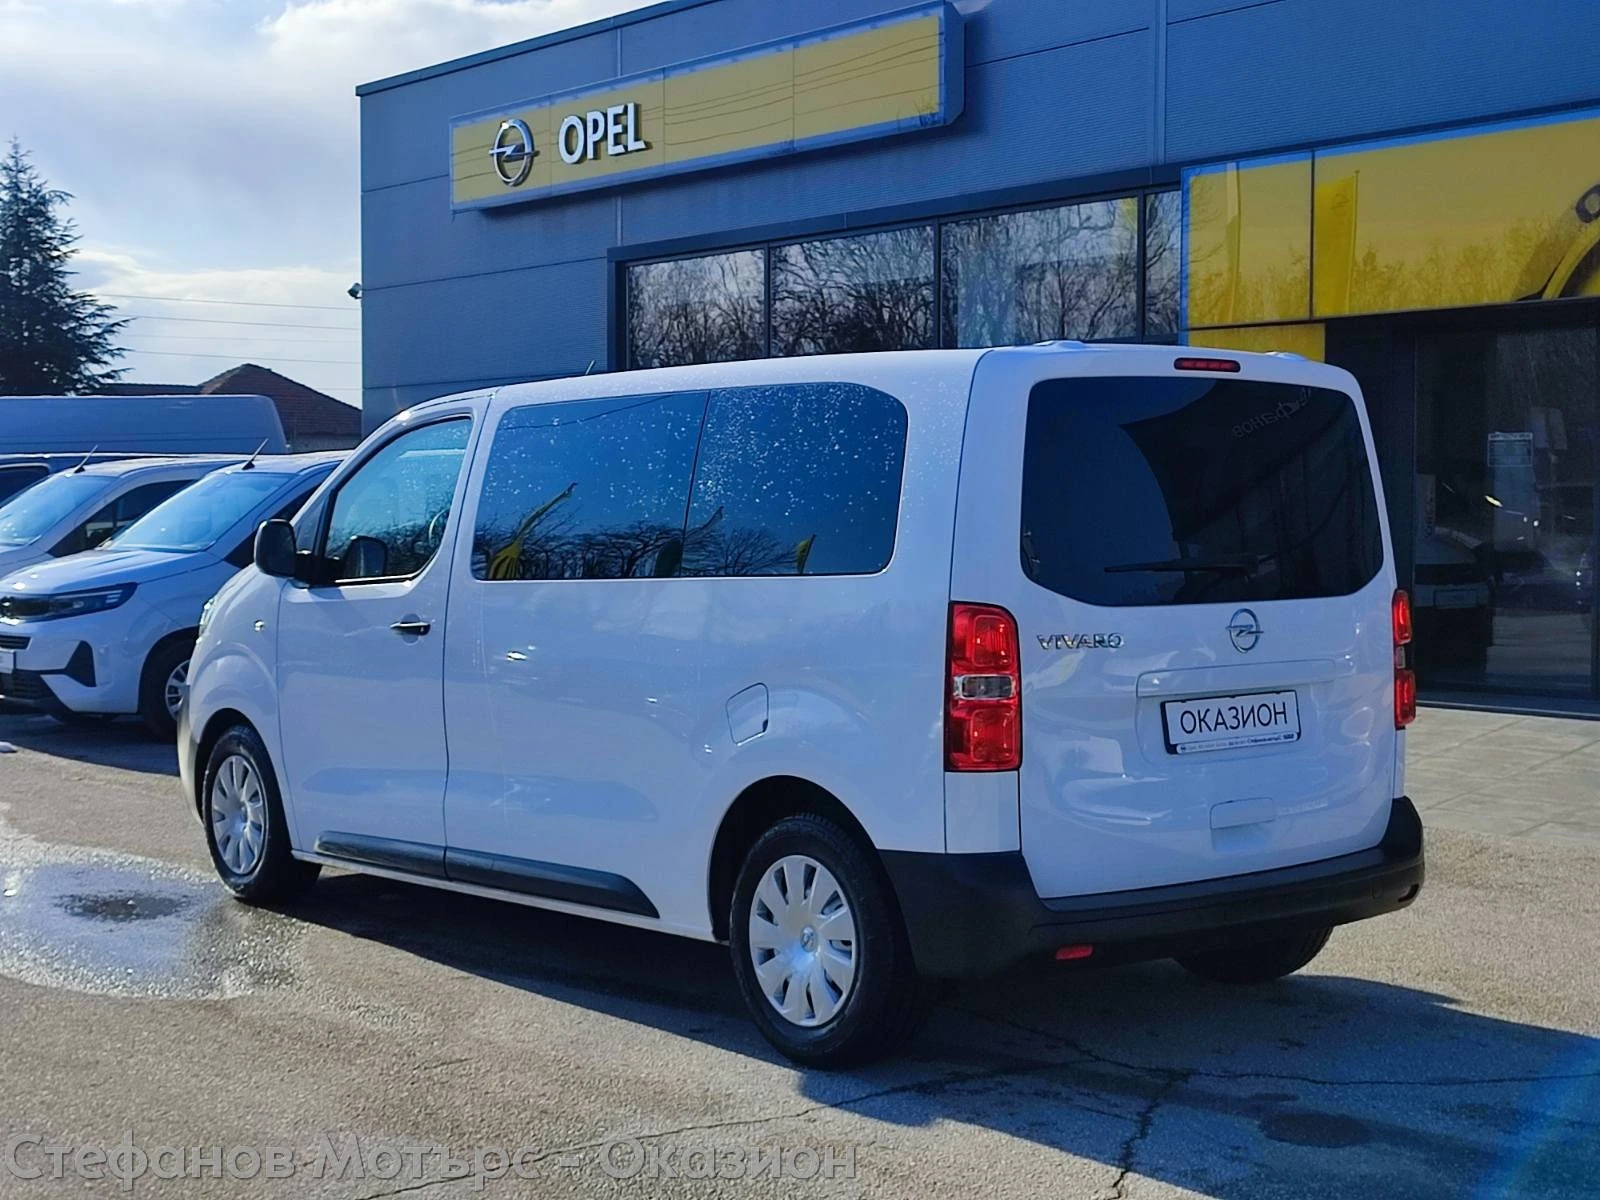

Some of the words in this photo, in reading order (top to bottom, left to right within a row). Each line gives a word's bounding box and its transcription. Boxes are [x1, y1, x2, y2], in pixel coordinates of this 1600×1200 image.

[558, 101, 648, 164] OPEL
[1037, 633, 1124, 650] VIVARO
[1180, 702, 1288, 735] ОКАЗИОН
